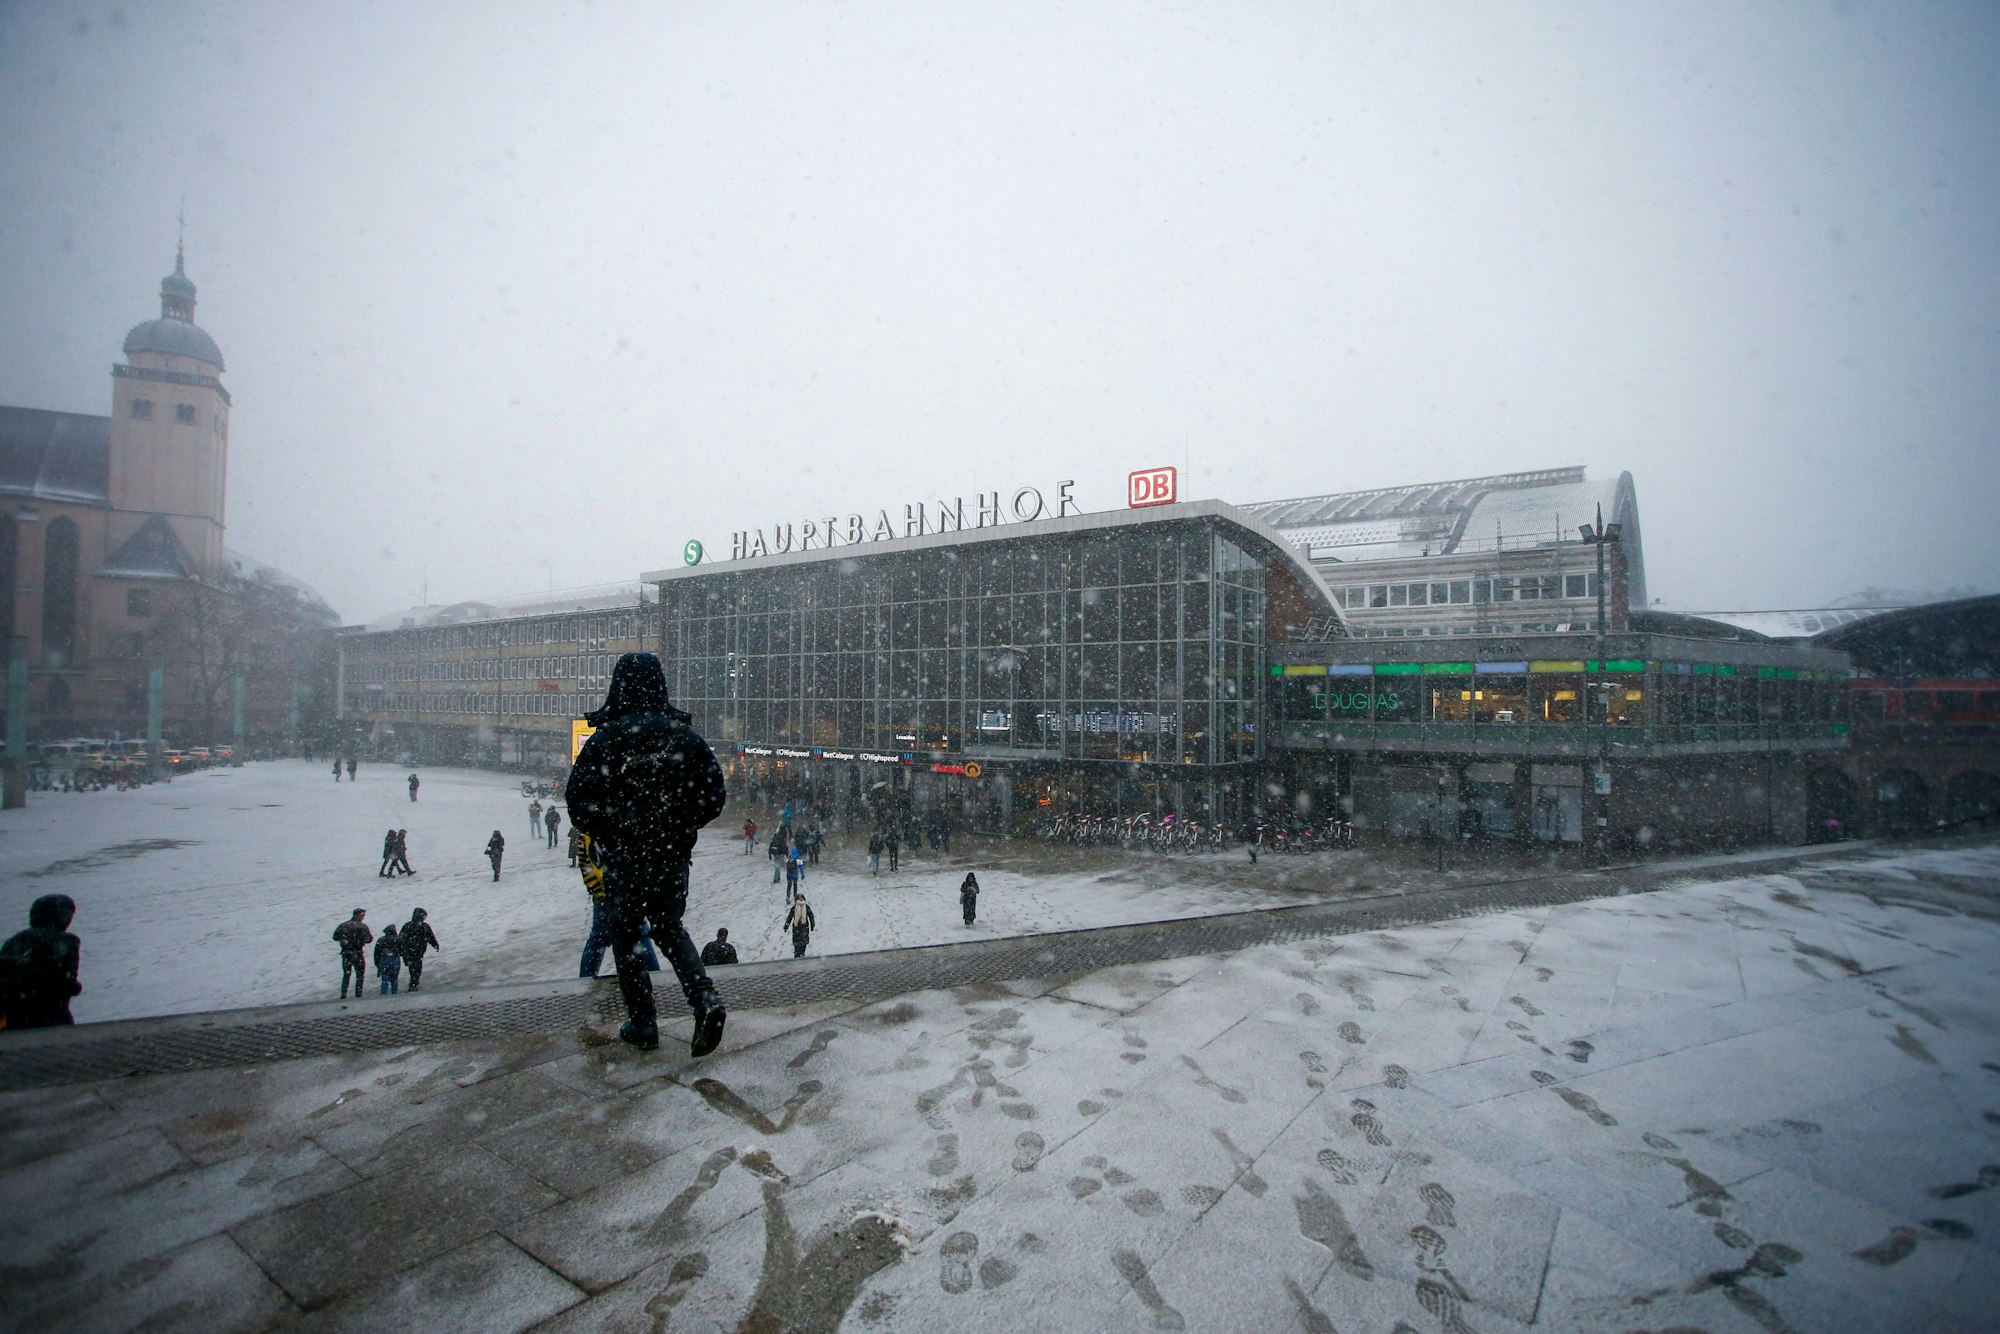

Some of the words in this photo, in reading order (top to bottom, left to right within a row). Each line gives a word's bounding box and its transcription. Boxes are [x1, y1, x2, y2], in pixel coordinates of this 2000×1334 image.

[1134, 474, 1169, 502] DB
[730, 480, 1074, 560] HAUPTBAHNHOF
[686, 542, 697, 563] S
[744, 747, 772, 756] NetCologne
[783, 749, 810, 758] Highspeed
[822, 751, 854, 761] NetCologne
[868, 754, 899, 763] Highspeed
